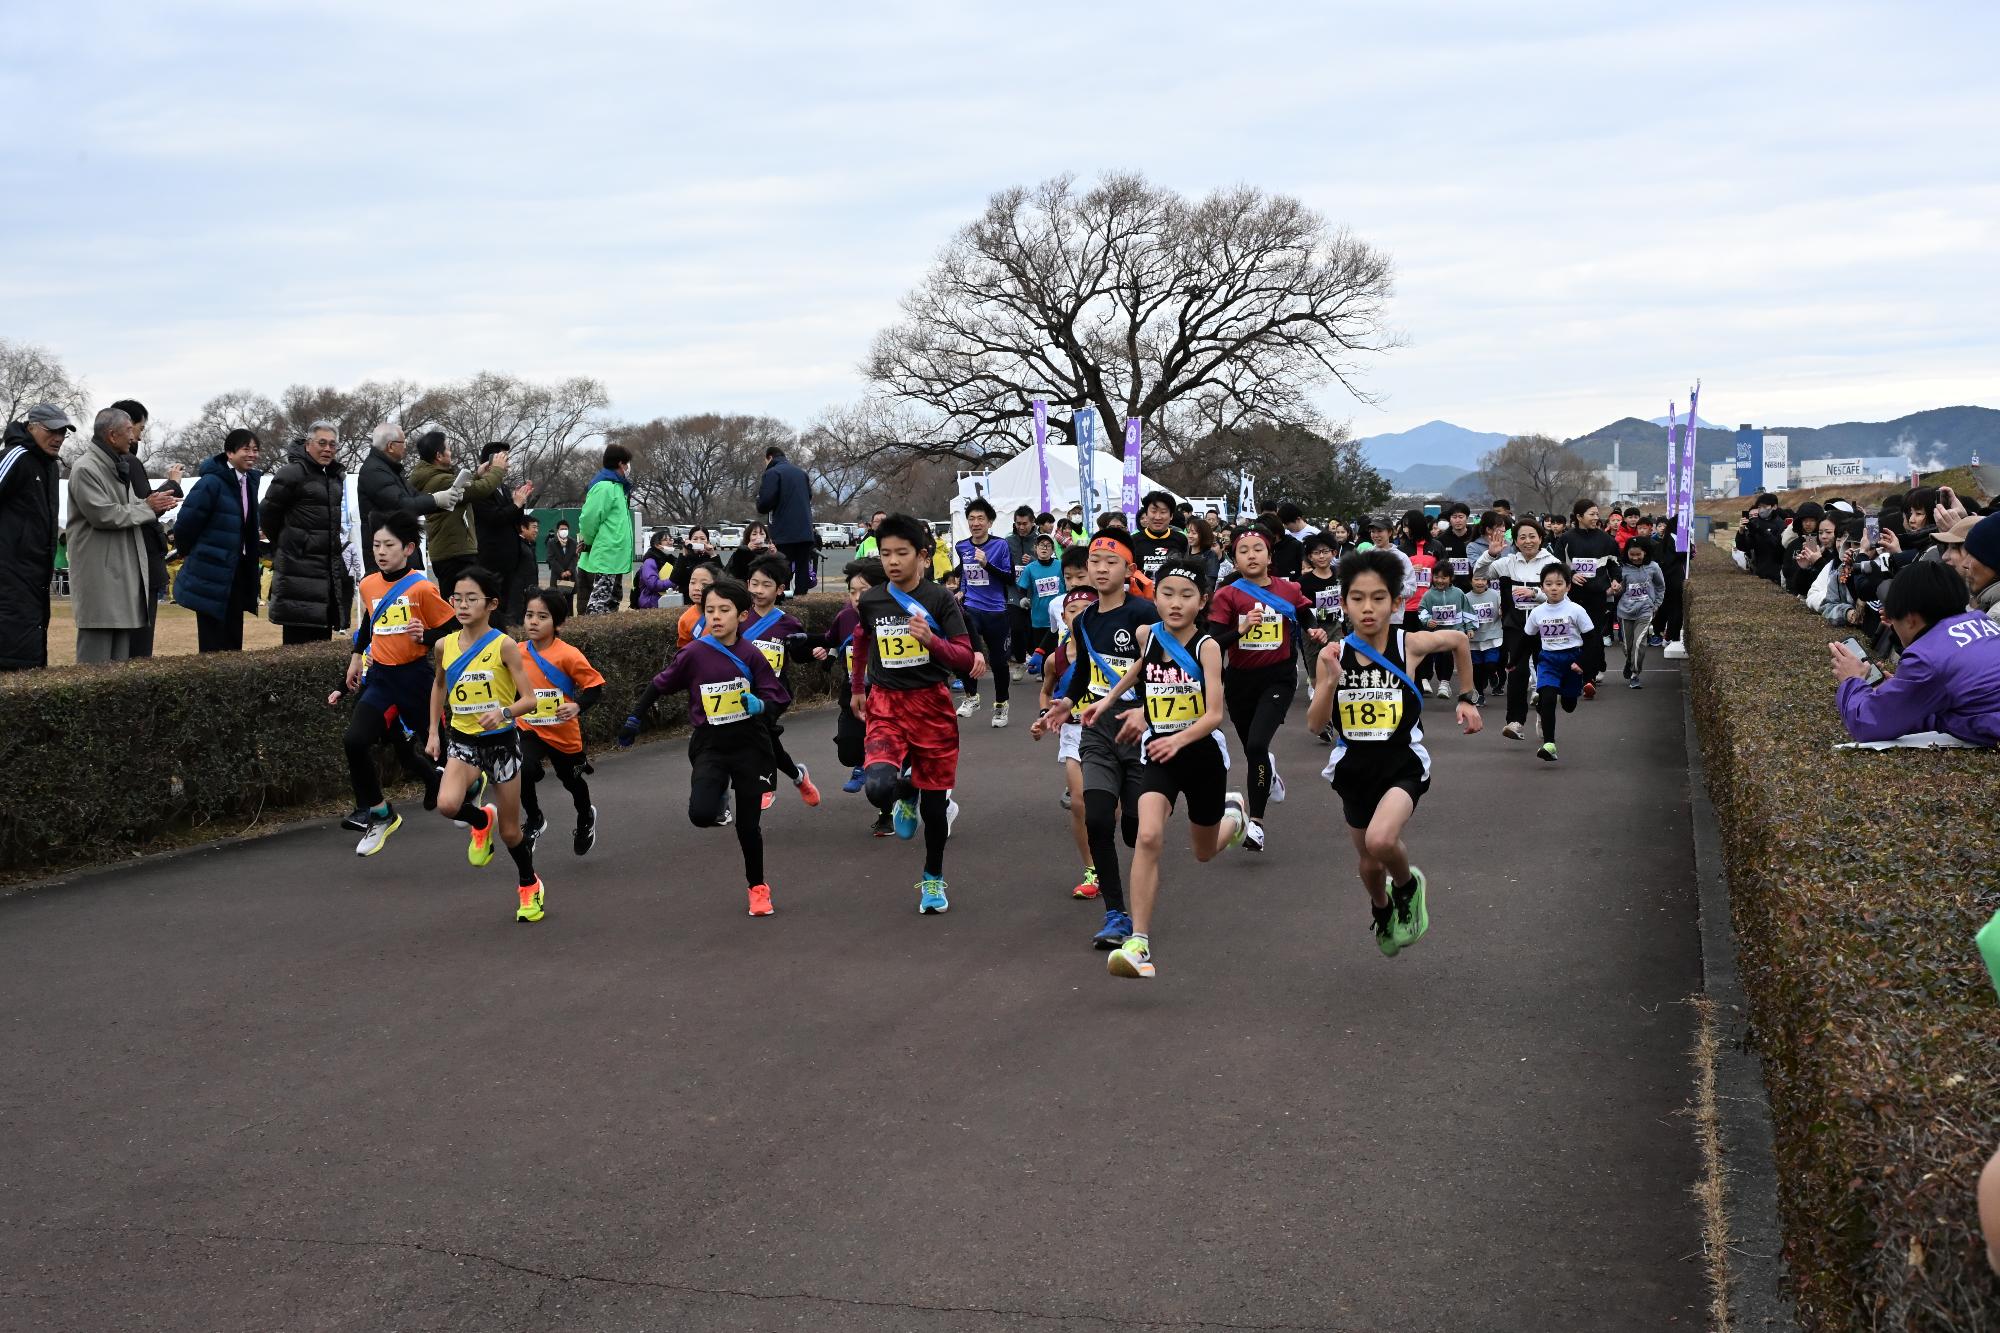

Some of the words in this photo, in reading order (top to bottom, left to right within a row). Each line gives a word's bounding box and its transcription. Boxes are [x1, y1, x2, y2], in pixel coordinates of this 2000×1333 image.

[1575, 562, 1594, 572] 202
[967, 570, 985, 580] 221
[1415, 572, 1428, 582] 11
[1039, 582, 1057, 592] 219
[1320, 595, 1340, 607] 205
[1435, 610, 1455, 620] 204
[883, 626, 910, 636] サンワ開
[1542, 624, 1567, 636] 222
[882, 637, 923, 656] 13-1
[456, 681, 492, 702] 6-1
[707, 682, 743, 693] サンワ開発
[1152, 685, 1193, 694] サンワ開発
[1347, 691, 1393, 701] サンワ開発
[1150, 694, 1199, 718] 17-1
[1345, 703, 1397, 726] 18-1
